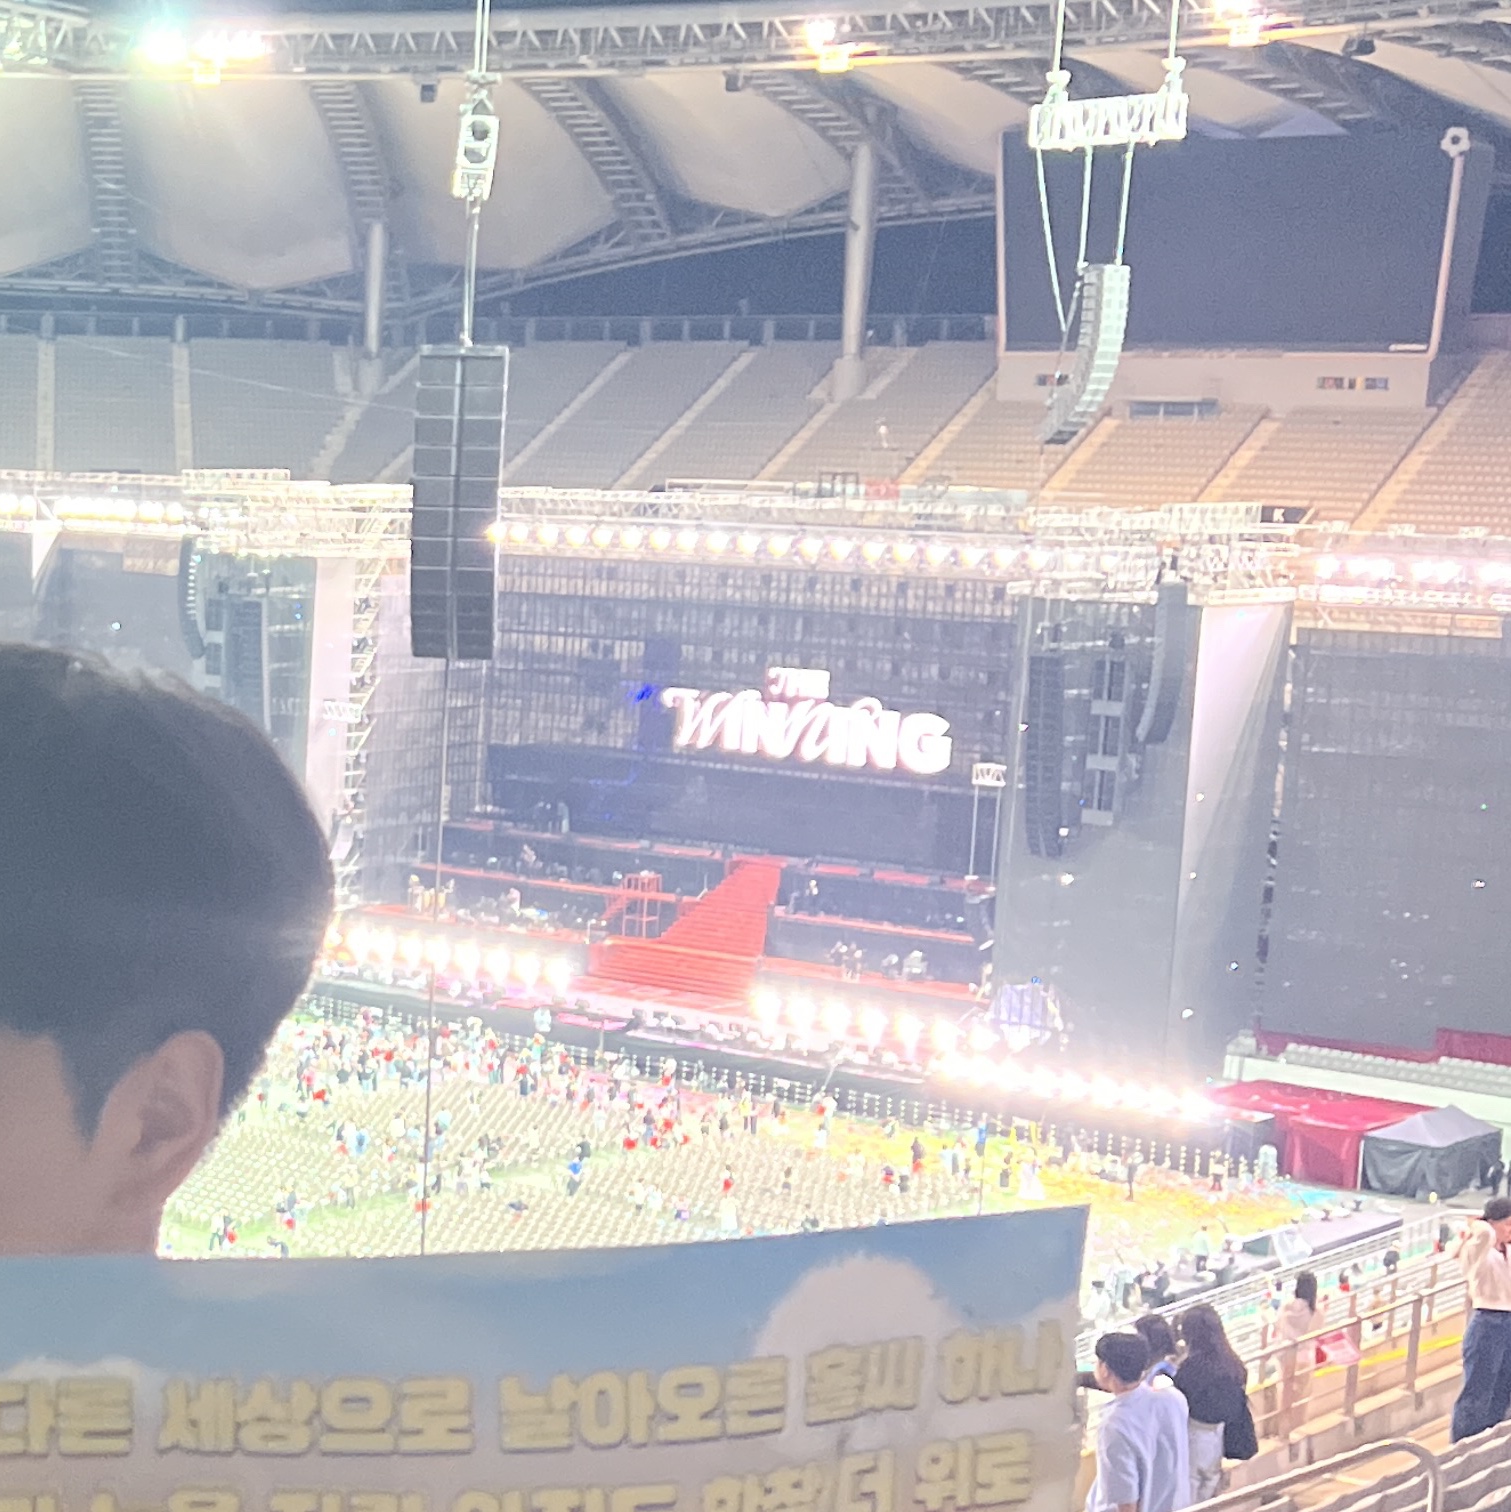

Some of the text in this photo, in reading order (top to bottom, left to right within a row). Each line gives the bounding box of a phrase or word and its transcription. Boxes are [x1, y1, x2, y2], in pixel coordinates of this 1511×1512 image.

[155, 1375, 475, 1456] 세상으로
[498, 1354, 788, 1455] 날아오른
[940, 1318, 1062, 1405] 하나
